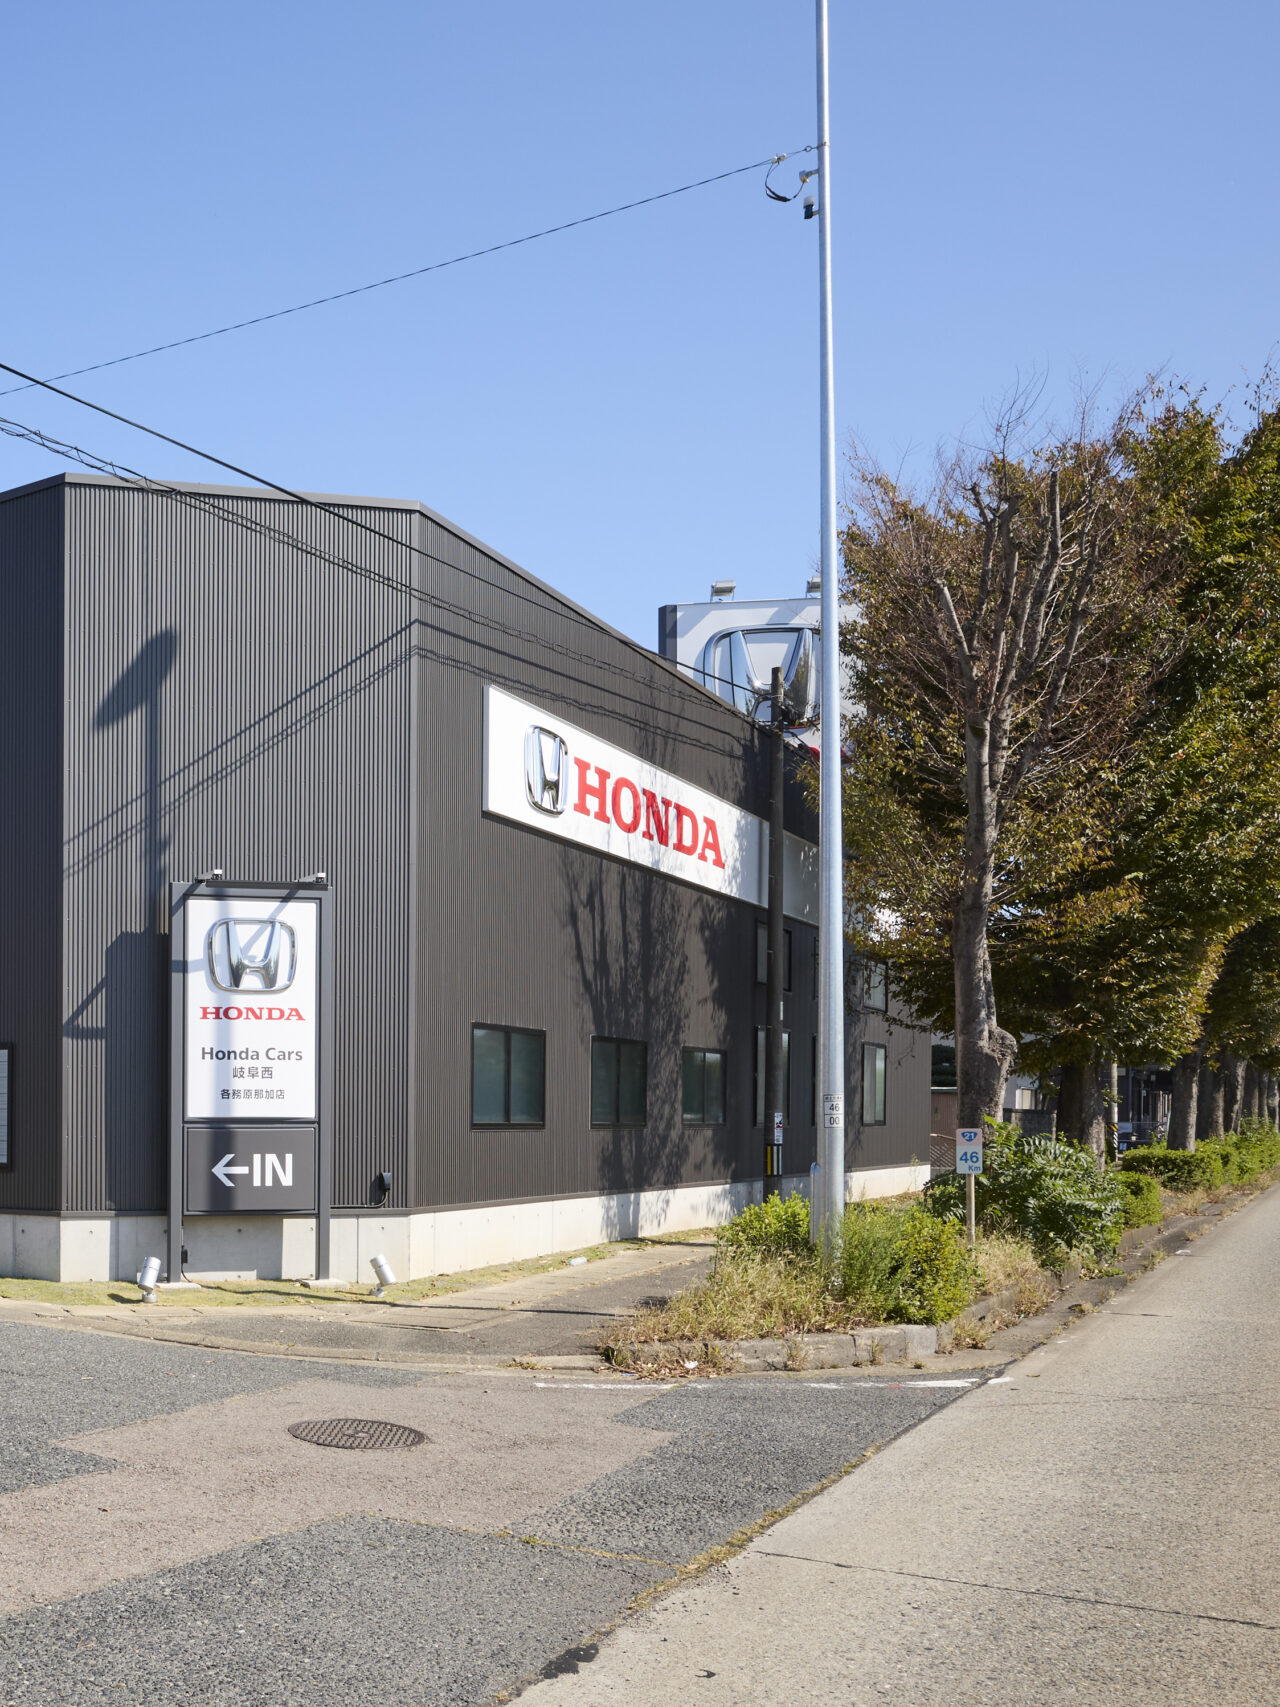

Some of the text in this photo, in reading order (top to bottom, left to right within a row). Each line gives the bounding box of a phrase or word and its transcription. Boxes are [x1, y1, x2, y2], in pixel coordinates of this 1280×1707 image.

[573, 756, 726, 870] HONDA
[199, 1006, 306, 1021] HONDA
[201, 1047, 303, 1061] Honda Cars
[232, 1066, 273, 1079] 岐阜西
[220, 1088, 285, 1100] 各務原那加店
[829, 1103, 840, 1111] 46
[829, 1116, 840, 1125] 00
[959, 1151, 979, 1163] 46
[252, 1153, 293, 1187] IN
